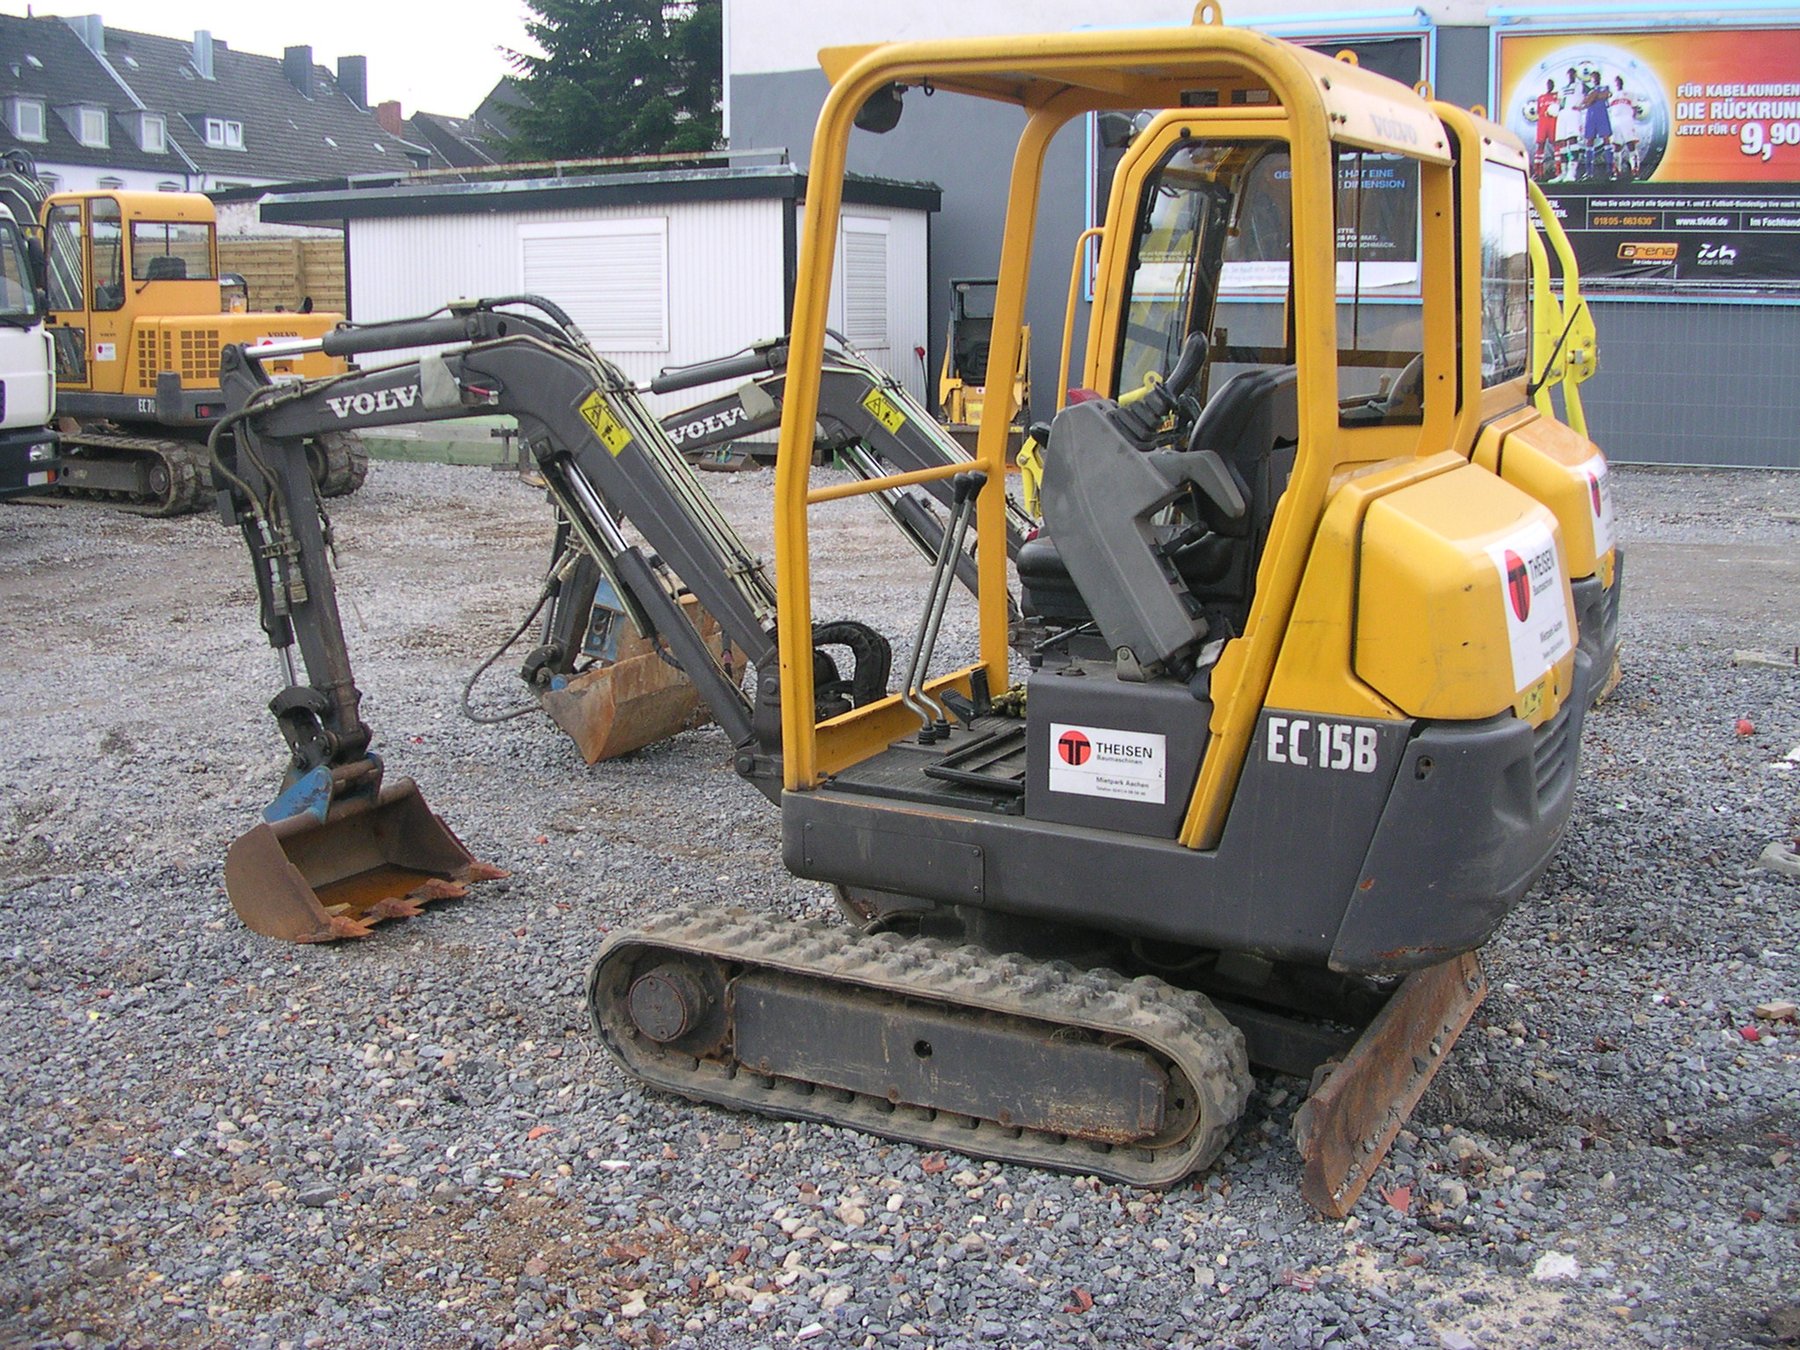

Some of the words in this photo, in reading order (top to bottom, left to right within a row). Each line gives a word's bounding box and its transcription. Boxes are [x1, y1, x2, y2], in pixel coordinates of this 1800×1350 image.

[1677, 83, 1702, 97] FÜR
[1705, 84, 1800, 97] KABELKUNDEN
[1676, 102, 1706, 119] DIE
[1710, 98, 1800, 119] RÜCKRUN
[1369, 112, 1417, 145] VOLVO
[1676, 124, 1706, 136] JETZT
[1707, 123, 1728, 136] FÜR
[1369, 169, 1394, 177] EINE
[1620, 245, 1675, 257] arena
[325, 384, 422, 419] VOLV
[1096, 741, 1153, 759] THEISEN
[1266, 716, 1310, 766] EC
[1317, 721, 1379, 774] 15B
[1125, 779, 1150, 788] Aachen
